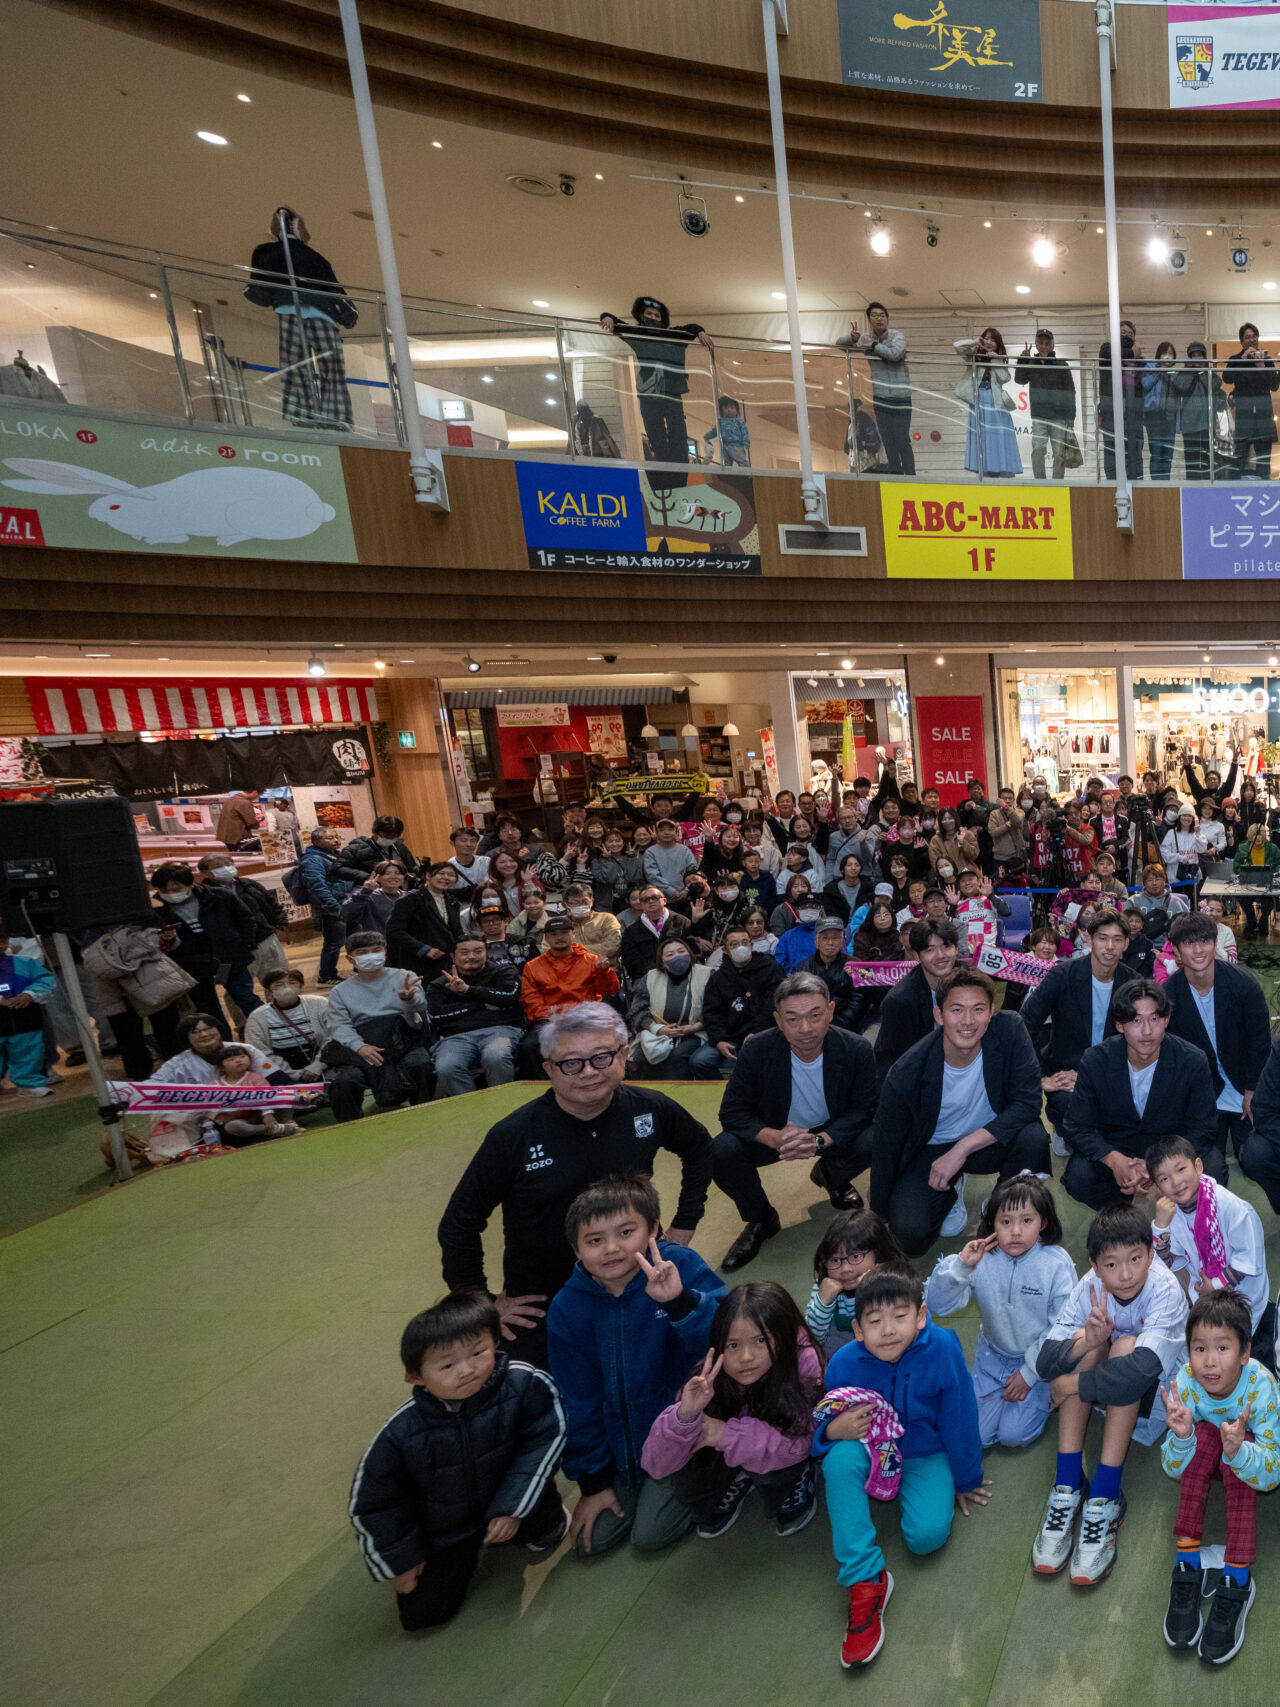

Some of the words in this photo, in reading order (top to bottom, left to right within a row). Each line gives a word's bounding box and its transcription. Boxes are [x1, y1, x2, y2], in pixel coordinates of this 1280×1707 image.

[869, 36, 886, 44] MORE
[912, 41, 937, 50] FASHION
[1014, 82, 1039, 98] 2F
[245, 449, 322, 467] room
[537, 490, 627, 518] KALDI
[549, 515, 588, 527] COFFEE
[592, 518, 620, 528] FARM
[899, 500, 1055, 533] ABC-MART
[0, 512, 37, 539] AL
[537, 550, 556, 566] 1F
[564, 554, 751, 570] コーヒーと輸入食材のワンダーショップ
[968, 547, 995, 572] 1F
[932, 727, 971, 741] SALE
[935, 771, 974, 784] SALE
[985, 953, 1003, 970] 58
[154, 1089, 278, 1107] TEGEVAJARO
[525, 1158, 553, 1171] ZOZO
